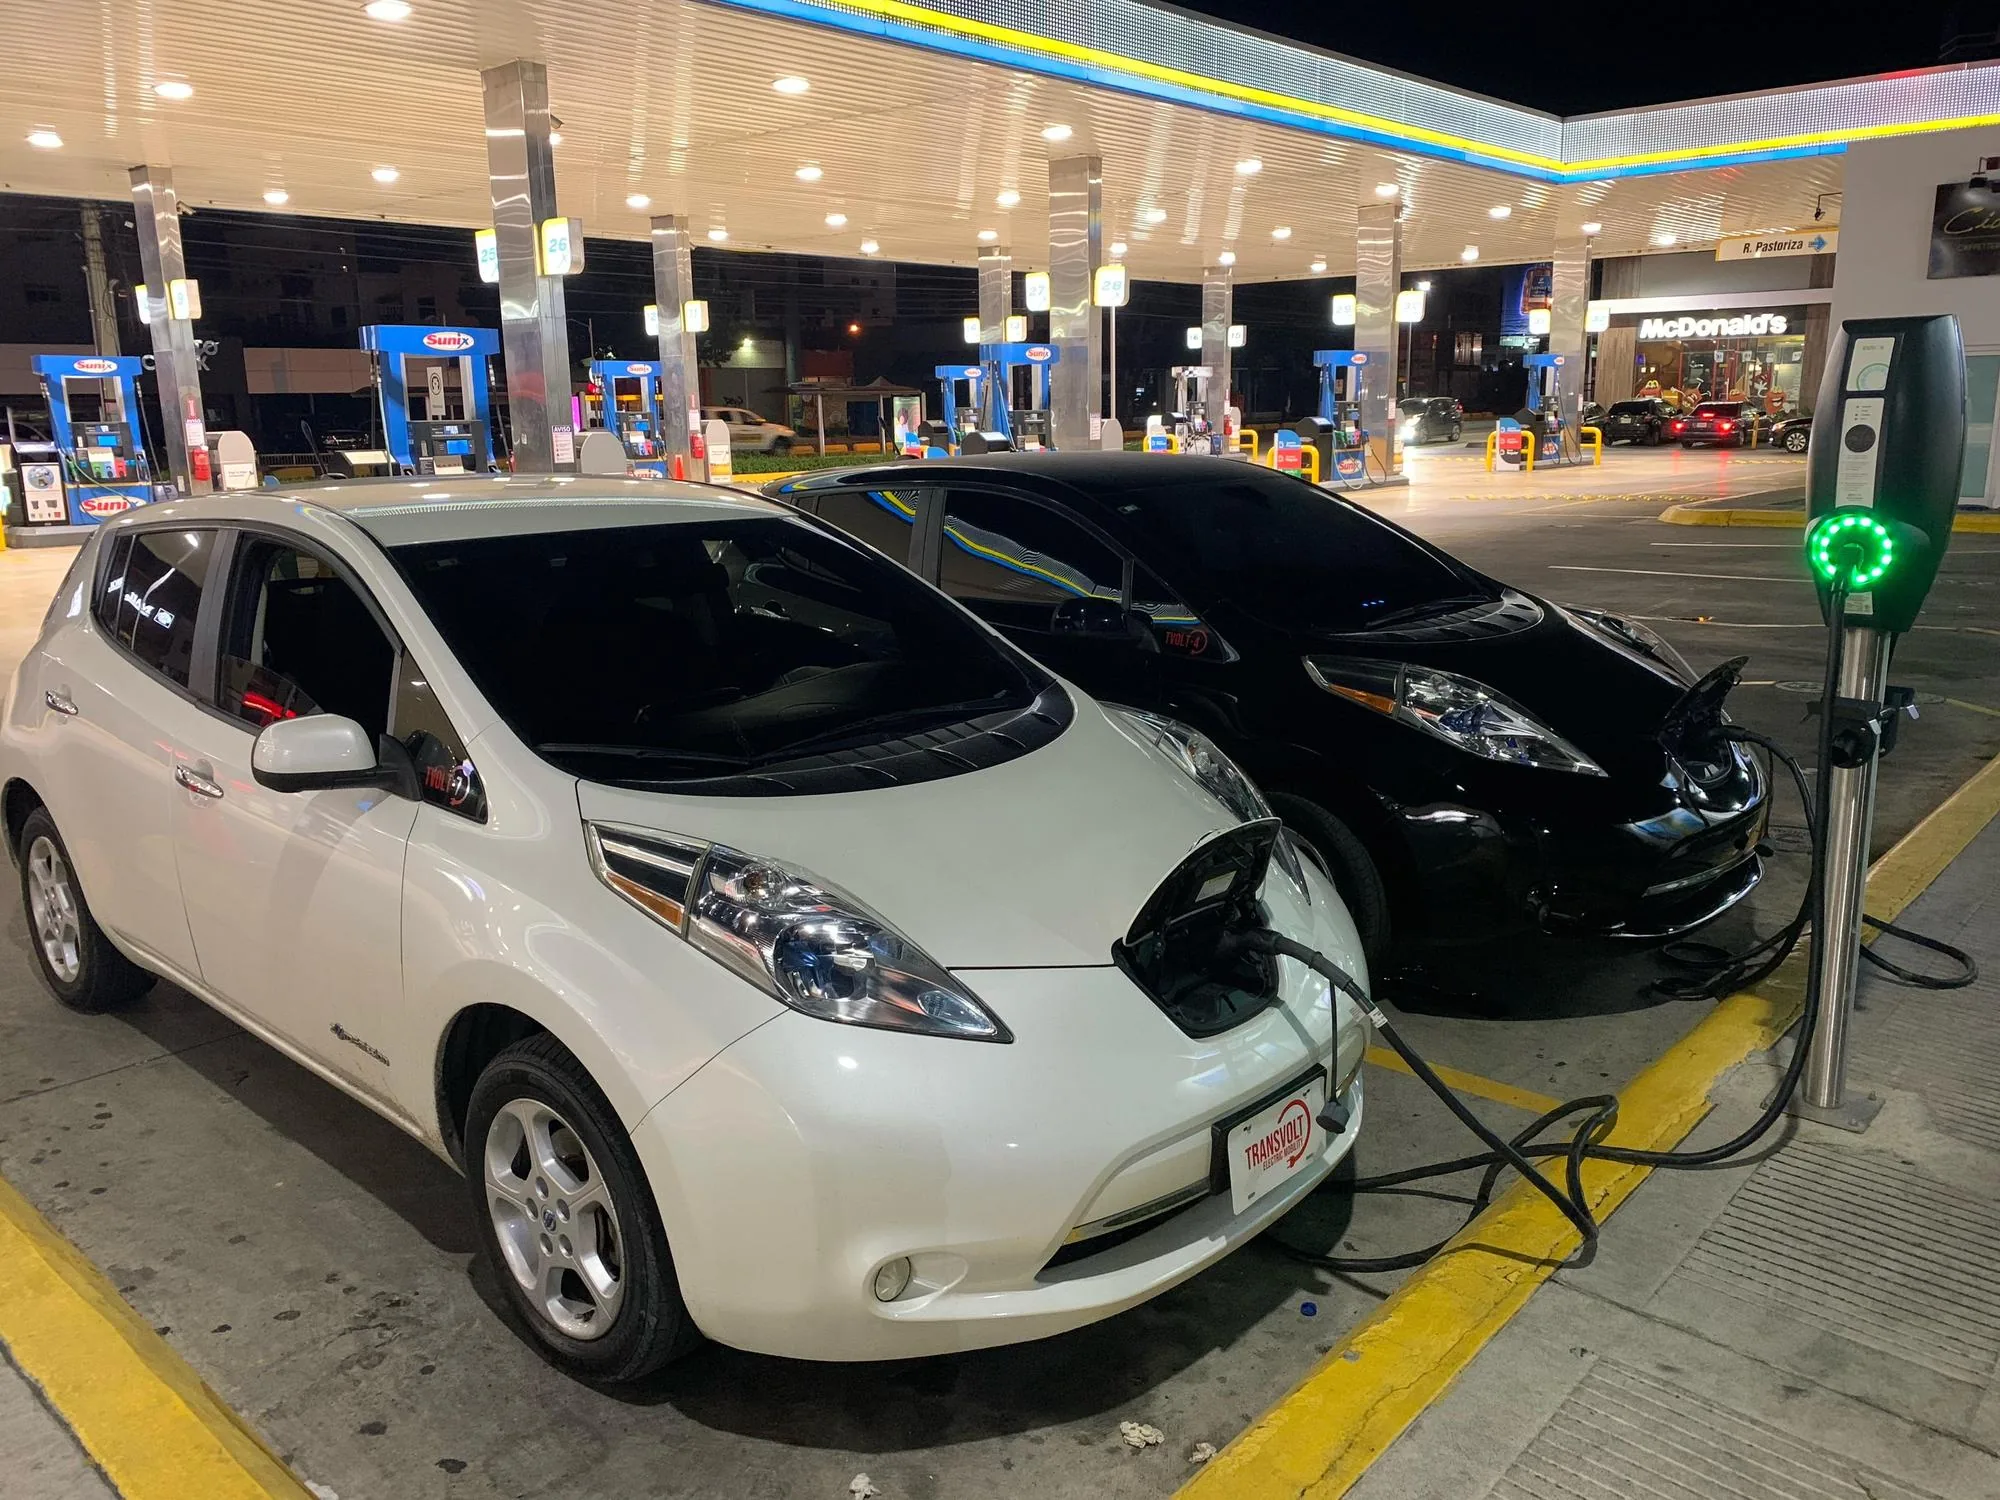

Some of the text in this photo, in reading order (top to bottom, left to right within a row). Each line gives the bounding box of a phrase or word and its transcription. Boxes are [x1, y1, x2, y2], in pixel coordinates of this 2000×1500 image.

[548, 237, 568, 253] 26
[1742, 242, 1753, 254] R.
[1755, 238, 1803, 253] Pastoriza
[481, 247, 497, 263] 25
[1029, 285, 1045, 297] 27
[1102, 281, 1122, 291] 28
[1639, 313, 1788, 339] McDonald's
[425, 332, 470, 349] Sunix
[1028, 348, 1049, 360] Sunix
[76, 360, 113, 373] Sunix
[629, 363, 650, 374] Sunix
[553, 425, 571, 433] AVISO
[1338, 457, 1361, 473] Sunix
[1244, 1114, 1304, 1170] TRANSVOLT
[1262, 1150, 1284, 1171] ELECTRIC
